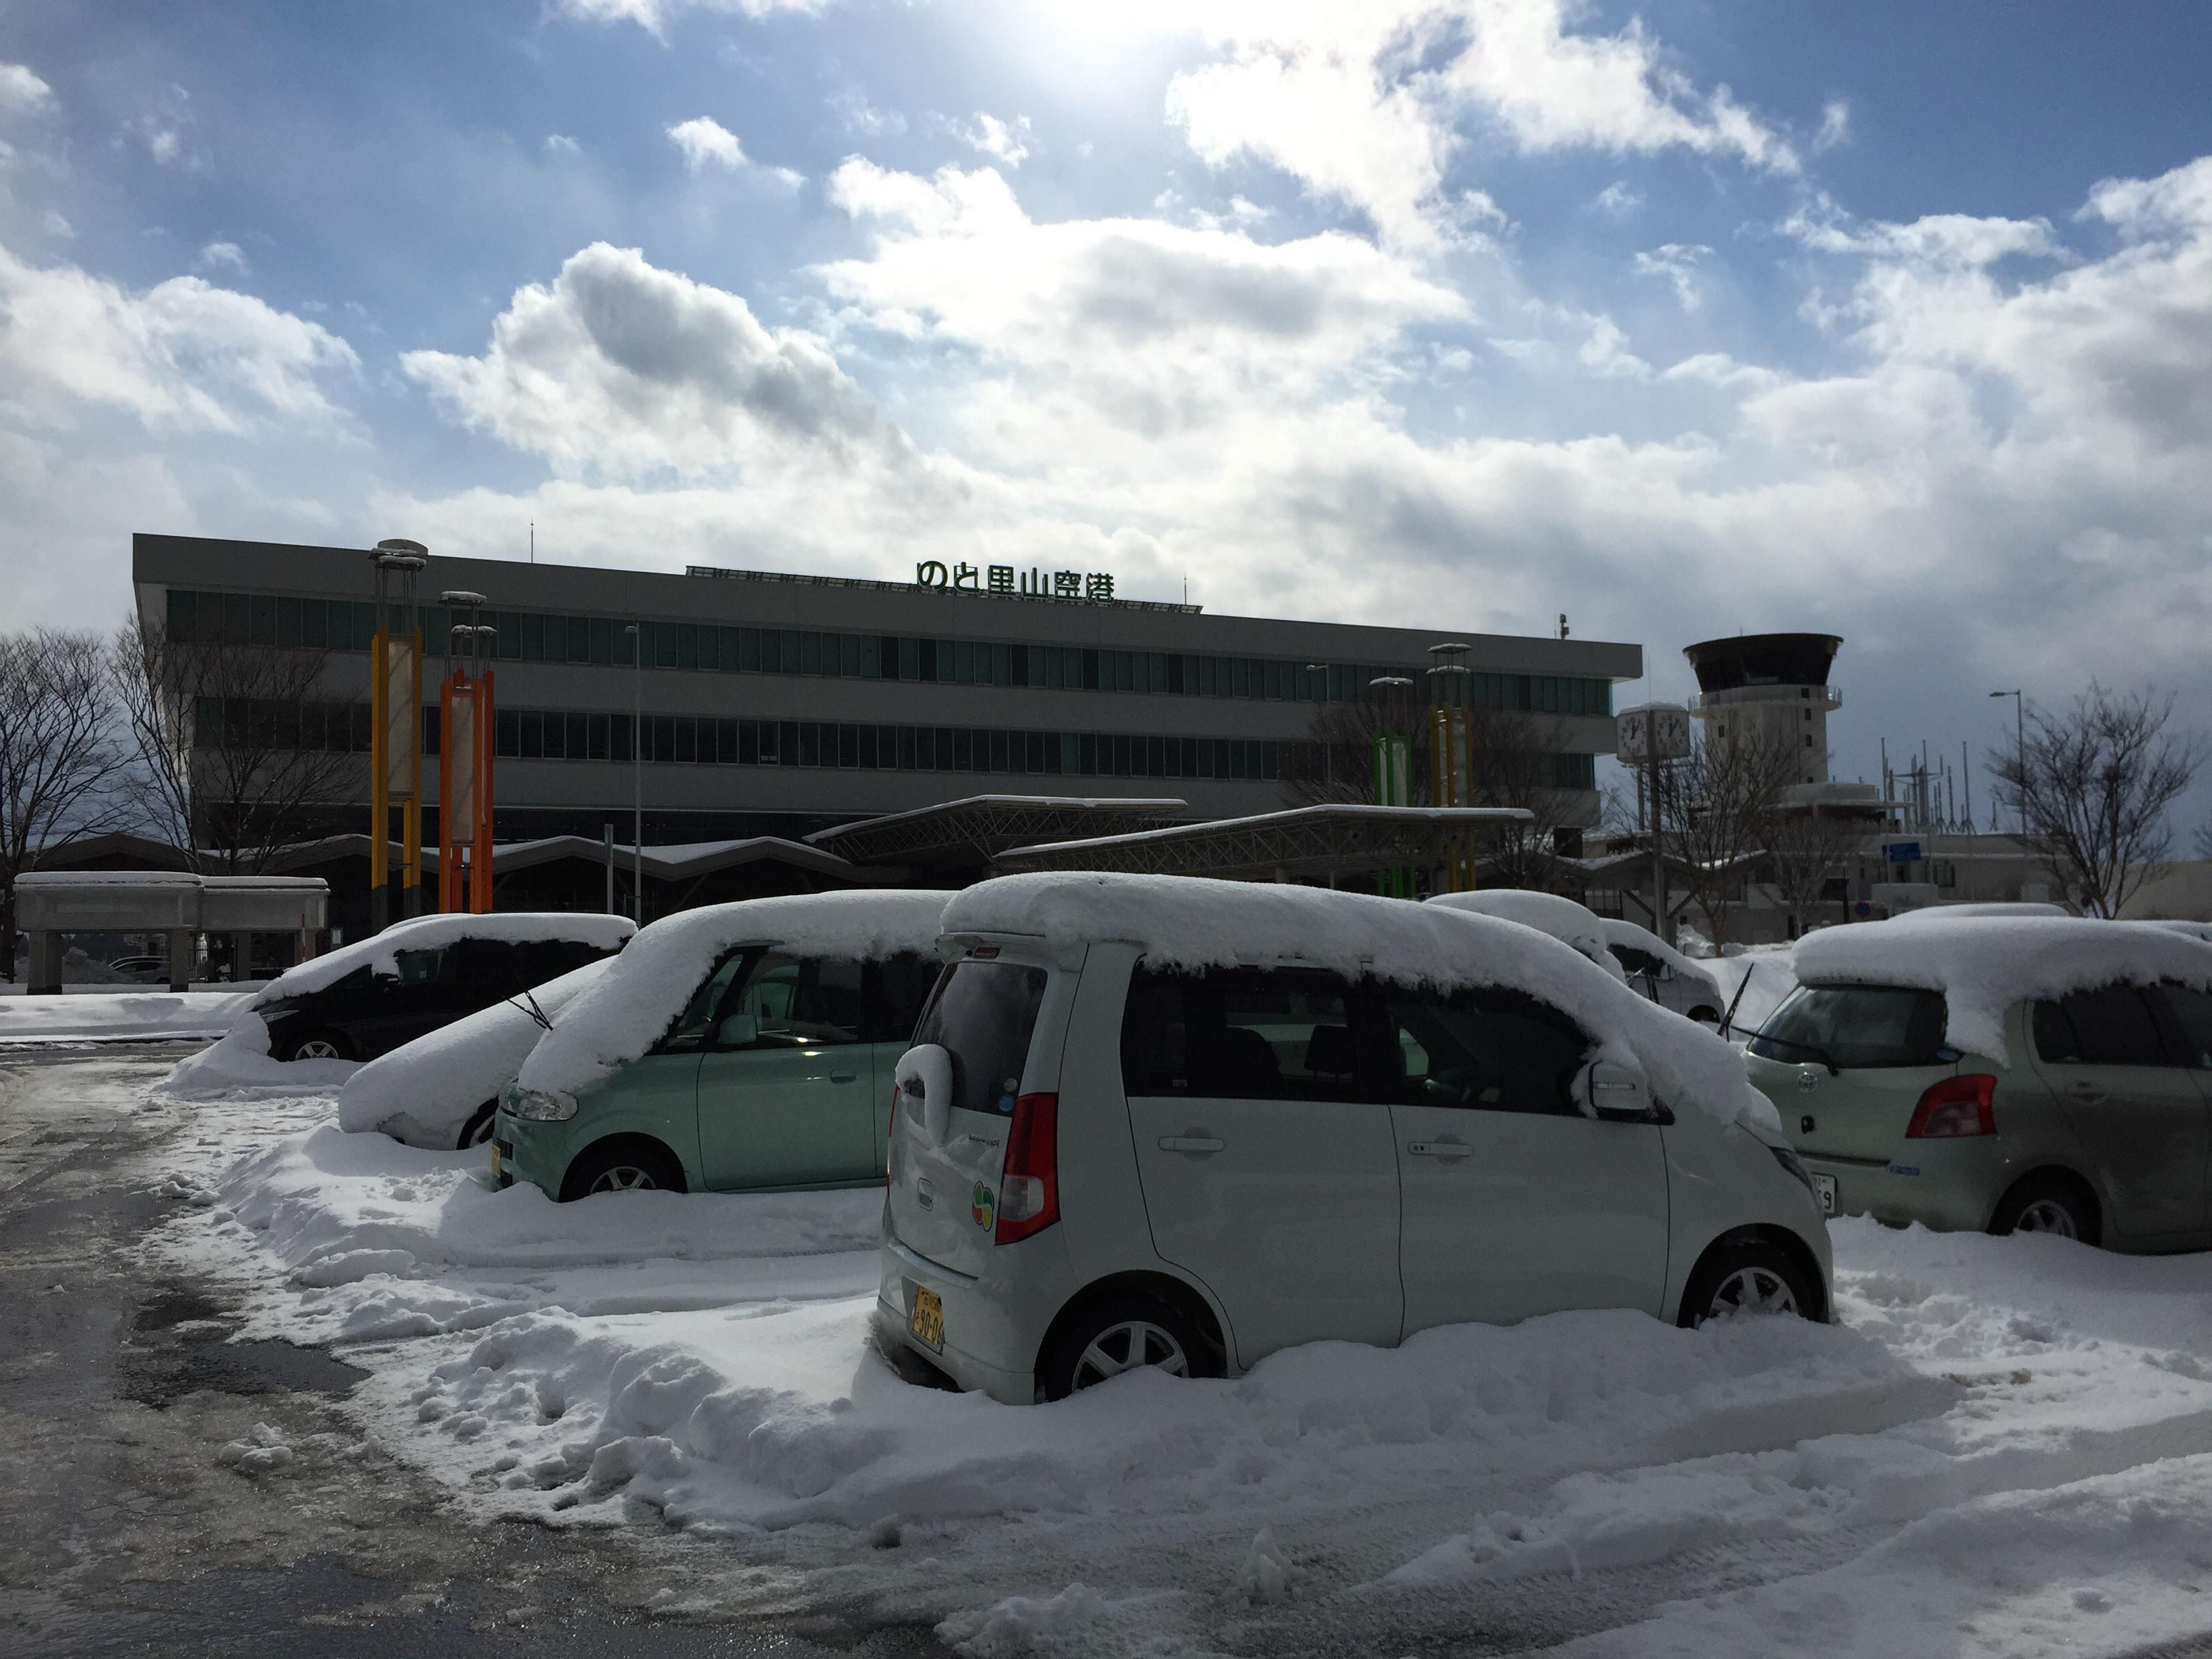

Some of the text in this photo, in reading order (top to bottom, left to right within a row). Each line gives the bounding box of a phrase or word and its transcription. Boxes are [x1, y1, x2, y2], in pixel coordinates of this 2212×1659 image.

[917, 560, 1115, 604] のと里山空港
